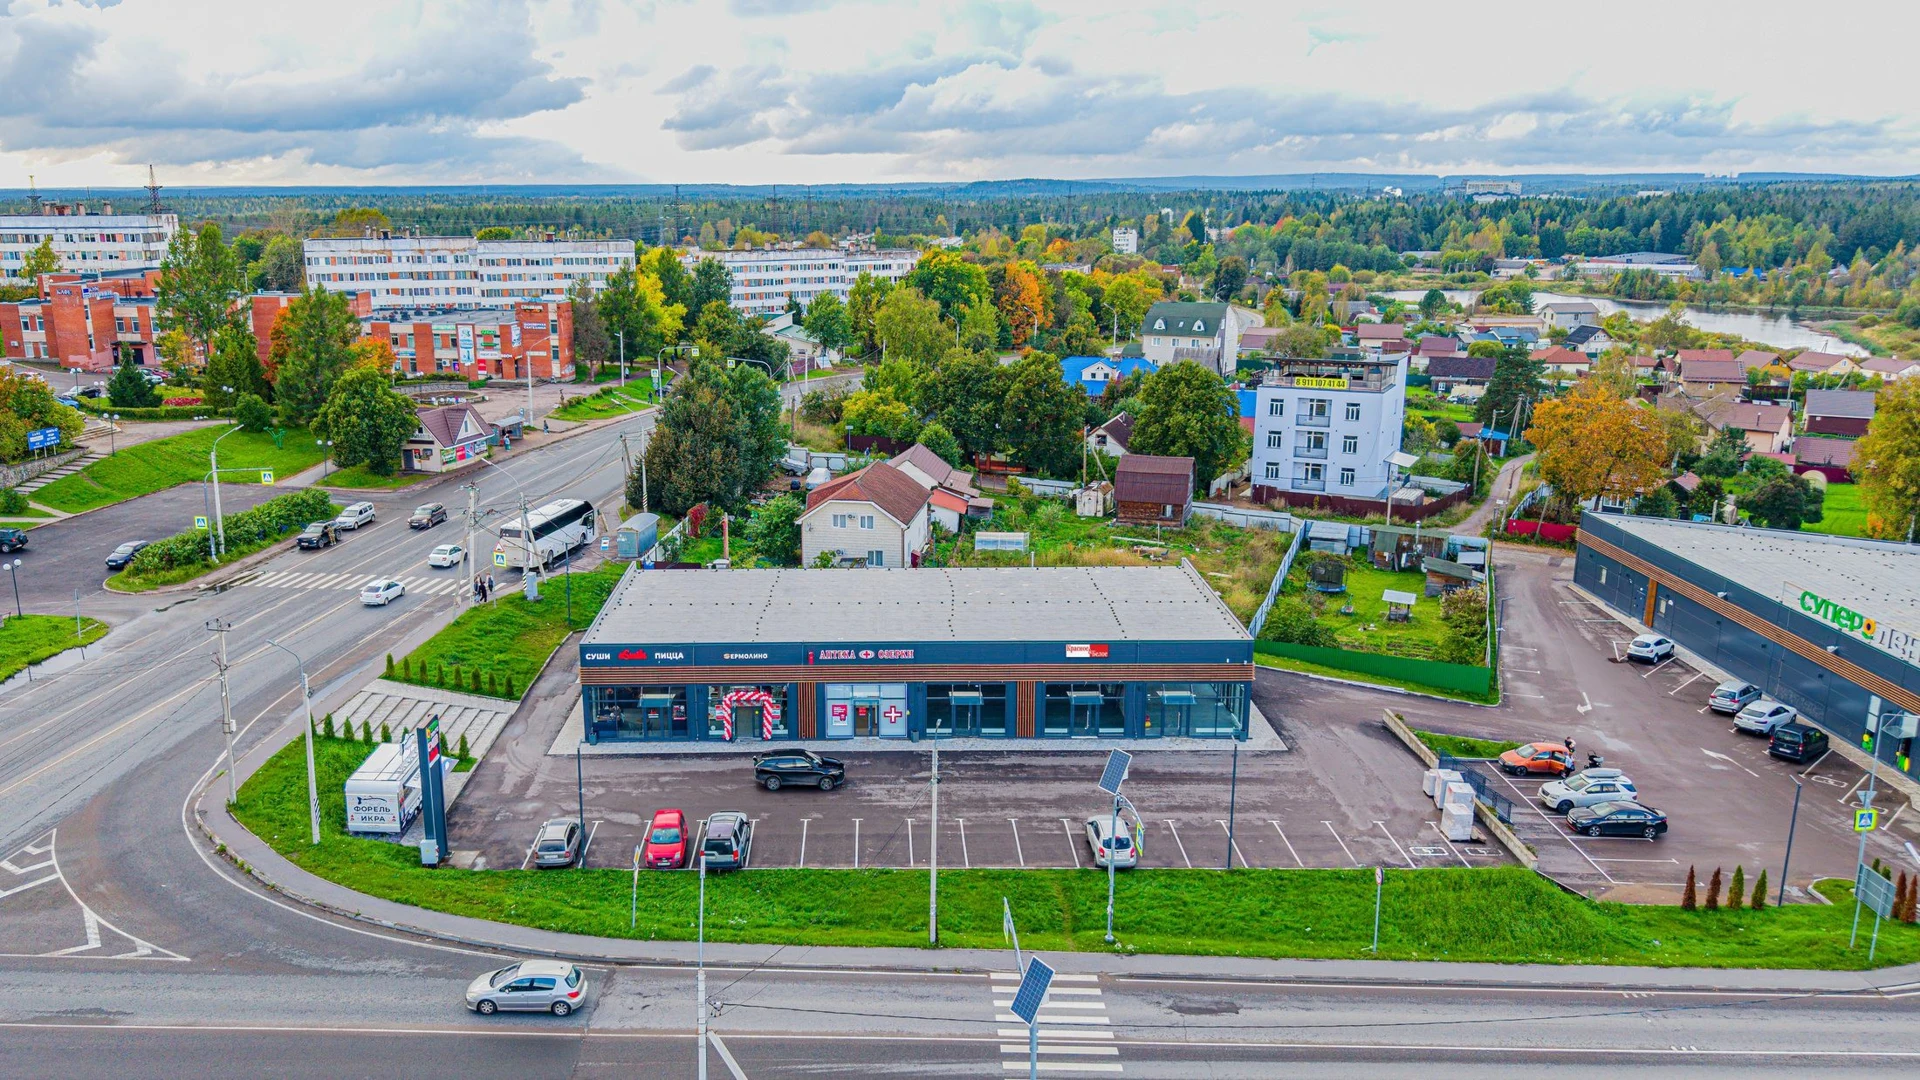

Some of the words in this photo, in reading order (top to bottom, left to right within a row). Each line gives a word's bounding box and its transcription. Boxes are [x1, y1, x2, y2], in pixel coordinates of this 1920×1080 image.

[1302, 379, 1314, 387] 911
[1315, 379, 1326, 387] 107
[1327, 380, 1335, 388] 41
[1337, 380, 1346, 388] 44
[655, 652, 684, 660] ПИЦЦА
[819, 650, 856, 660] АПТЕКА
[878, 649, 914, 659] ОЗЕРКИ
[353, 805, 391, 813] ФОРЕЛЬ
